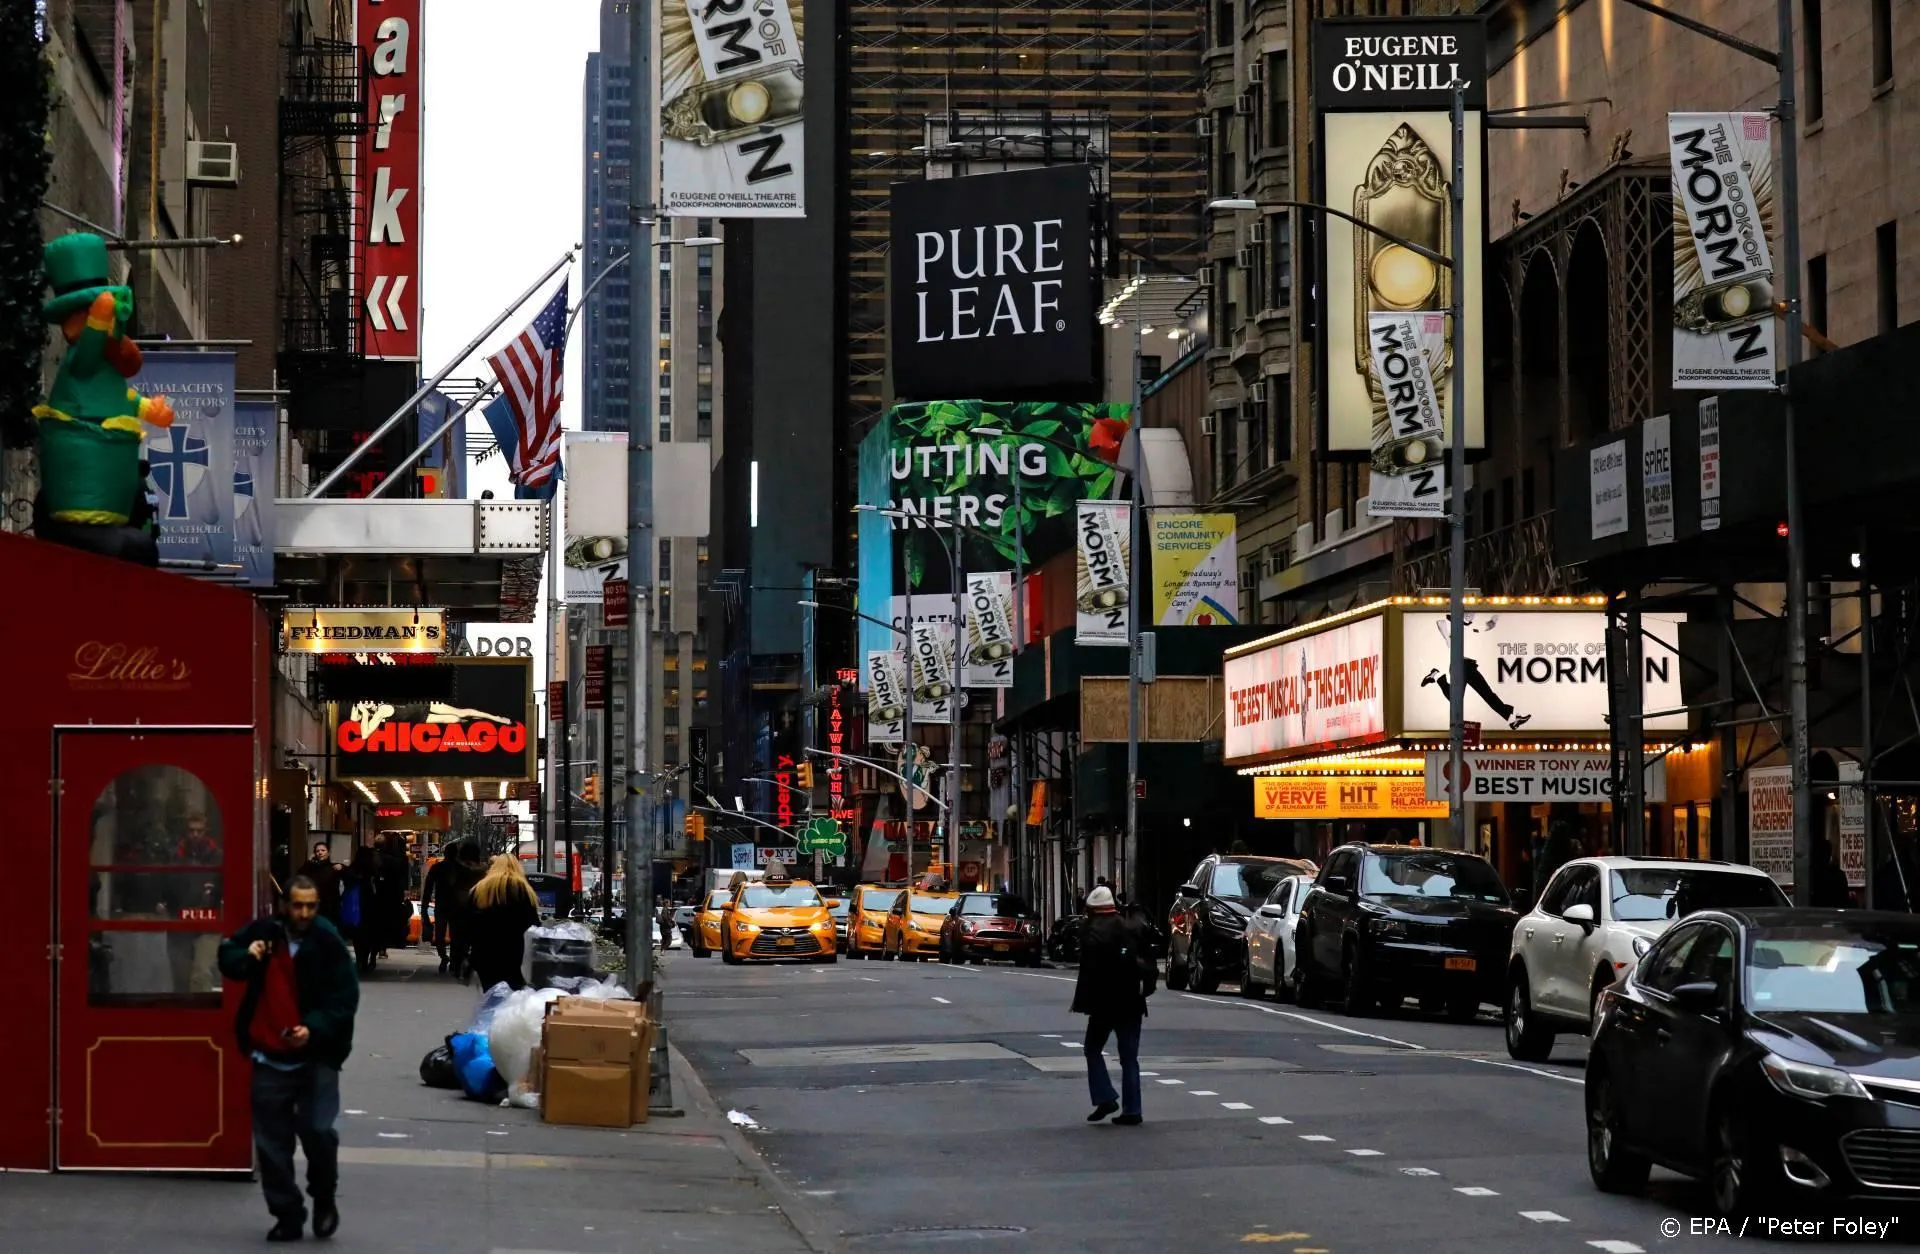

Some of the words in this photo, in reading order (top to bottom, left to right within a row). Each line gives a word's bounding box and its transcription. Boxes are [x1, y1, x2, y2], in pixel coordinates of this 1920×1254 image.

[1344, 35, 1459, 57] EUGENE
[1332, 59, 1472, 92] O'NEILL
[369, 0, 410, 243] ark
[679, 192, 717, 201] EUGENE
[718, 192, 753, 201] O'NEILL
[755, 193, 797, 201] THEATRE
[1708, 123, 1733, 166] THE
[1722, 170, 1752, 232] BOOK
[1744, 237, 1763, 268] OF
[670, 201, 797, 209] BOOKOFMORMONBROADWAY.COM
[914, 218, 1064, 285] PURE
[1398, 320, 1417, 352] THE
[1408, 356, 1429, 401] BOOK
[152, 383, 224, 393] MALACHY'S
[891, 442, 1047, 480] UTTING
[1645, 438, 1670, 476] SPIRE
[1156, 520, 1204, 529] ENCORE
[1157, 531, 1225, 540] COMMUNITY
[1157, 542, 1212, 551] SERVICES
[290, 625, 441, 640] FRIEDMAN'S
[457, 636, 533, 657] ADOR
[1497, 642, 1528, 656] THE
[1533, 642, 1580, 656] BOOK
[66, 640, 192, 681] Lillie's
[1497, 656, 1669, 684] MORMN
[1247, 683, 1266, 724] BEST
[1266, 675, 1300, 721] MUSICAL
[1313, 667, 1332, 711] THIS
[337, 720, 527, 753] CHICAGO
[1474, 759, 1536, 771] WINNER
[1539, 759, 1580, 771] TONY
[1339, 785, 1378, 803] HIT
[1475, 777, 1534, 795] BEST
[1265, 790, 1328, 805] VERVE
[775, 848, 794, 858] NY
[182, 909, 217, 920] PULL
